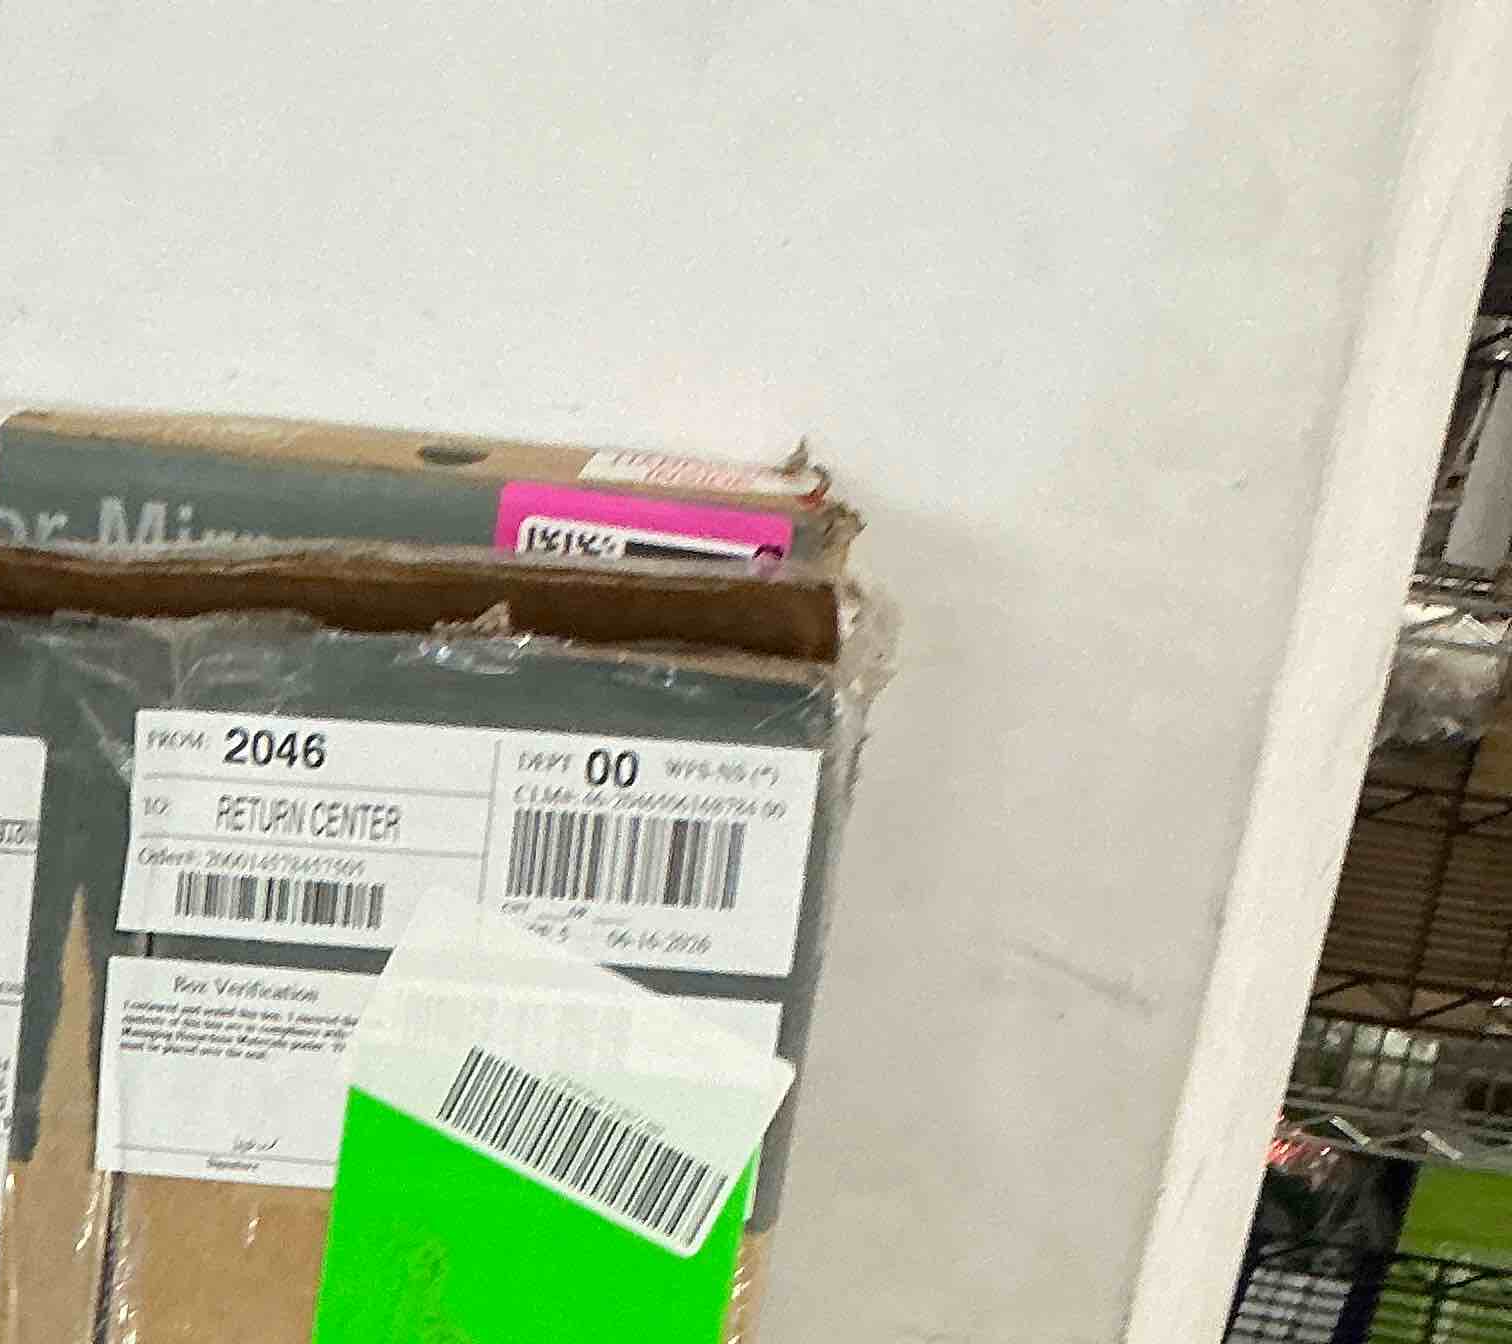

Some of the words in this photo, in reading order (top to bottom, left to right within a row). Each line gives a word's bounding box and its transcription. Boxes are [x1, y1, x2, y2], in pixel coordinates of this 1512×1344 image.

[223, 727, 327, 769] 2046
[585, 749, 640, 788] 00
[216, 794, 306, 834] RETURN
[311, 801, 401, 840] CENTER
